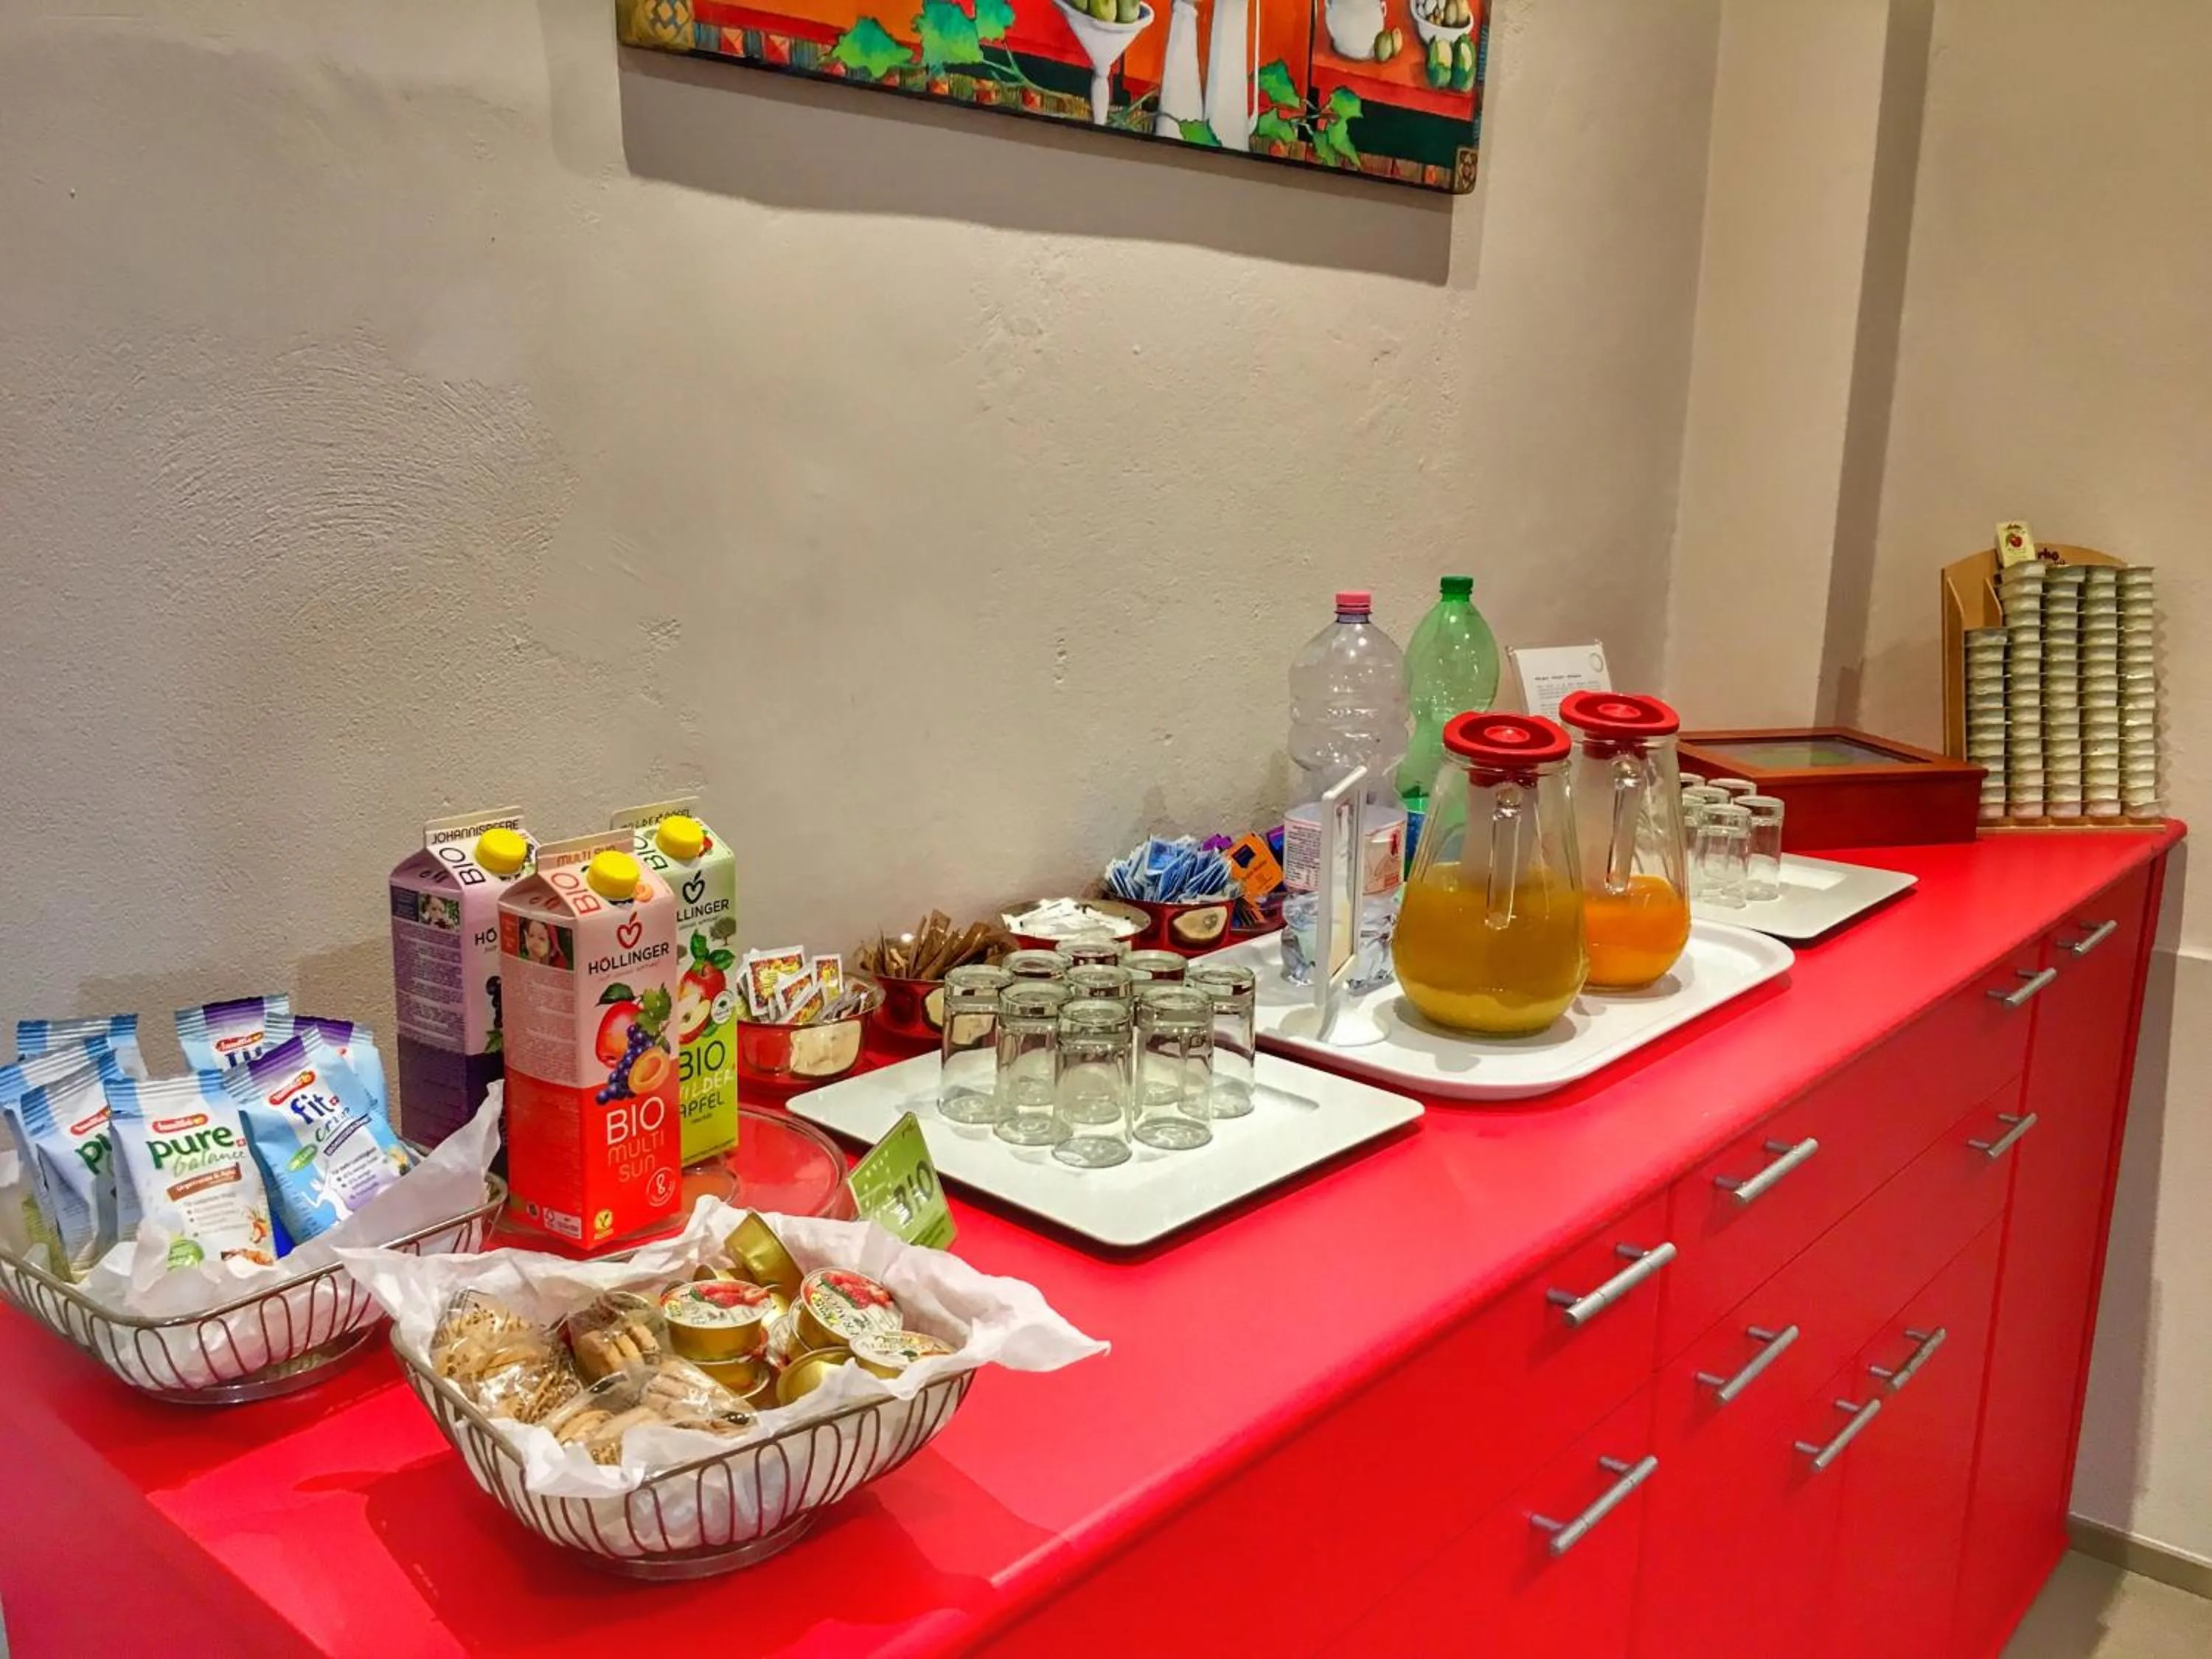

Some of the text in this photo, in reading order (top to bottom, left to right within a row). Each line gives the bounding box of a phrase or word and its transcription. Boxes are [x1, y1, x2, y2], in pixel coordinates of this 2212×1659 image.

[439, 847, 487, 886] BIO
[551, 872, 602, 916] BIO
[676, 899, 730, 922] LLINGER
[678, 1040, 726, 1082] BIO
[290, 1093, 335, 1125] fit
[606, 1096, 665, 1145] BIO
[146, 1127, 234, 1170] pure
[608, 1129, 664, 1168] MULTI
[619, 1155, 655, 1183] SUN
